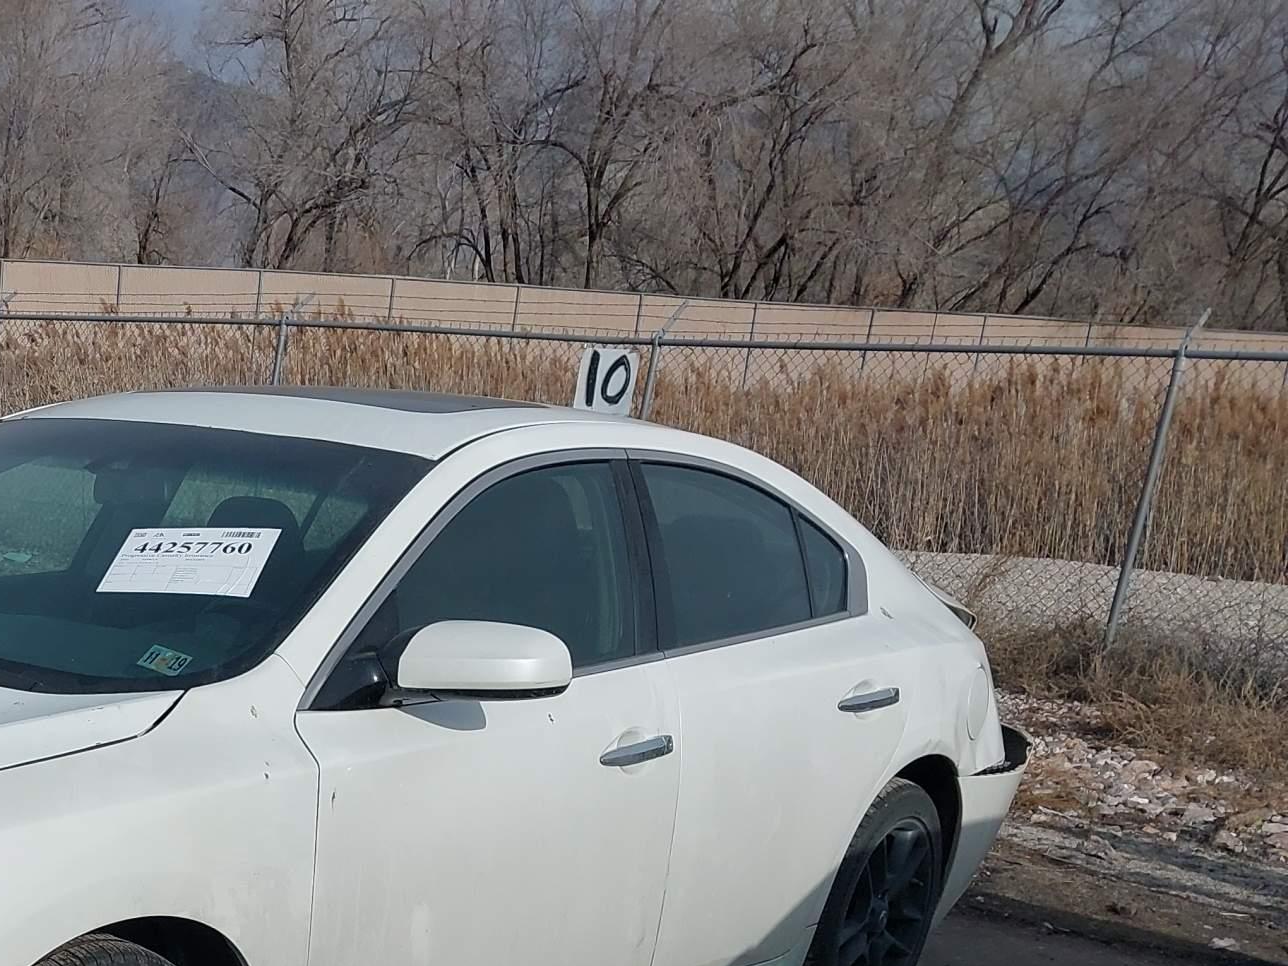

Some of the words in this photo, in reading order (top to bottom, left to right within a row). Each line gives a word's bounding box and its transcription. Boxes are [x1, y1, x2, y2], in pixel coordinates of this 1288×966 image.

[585, 349, 631, 406] 10
[133, 541, 253, 554] 44257760
[143, 651, 161, 665] 11
[168, 655, 188, 672] 19
